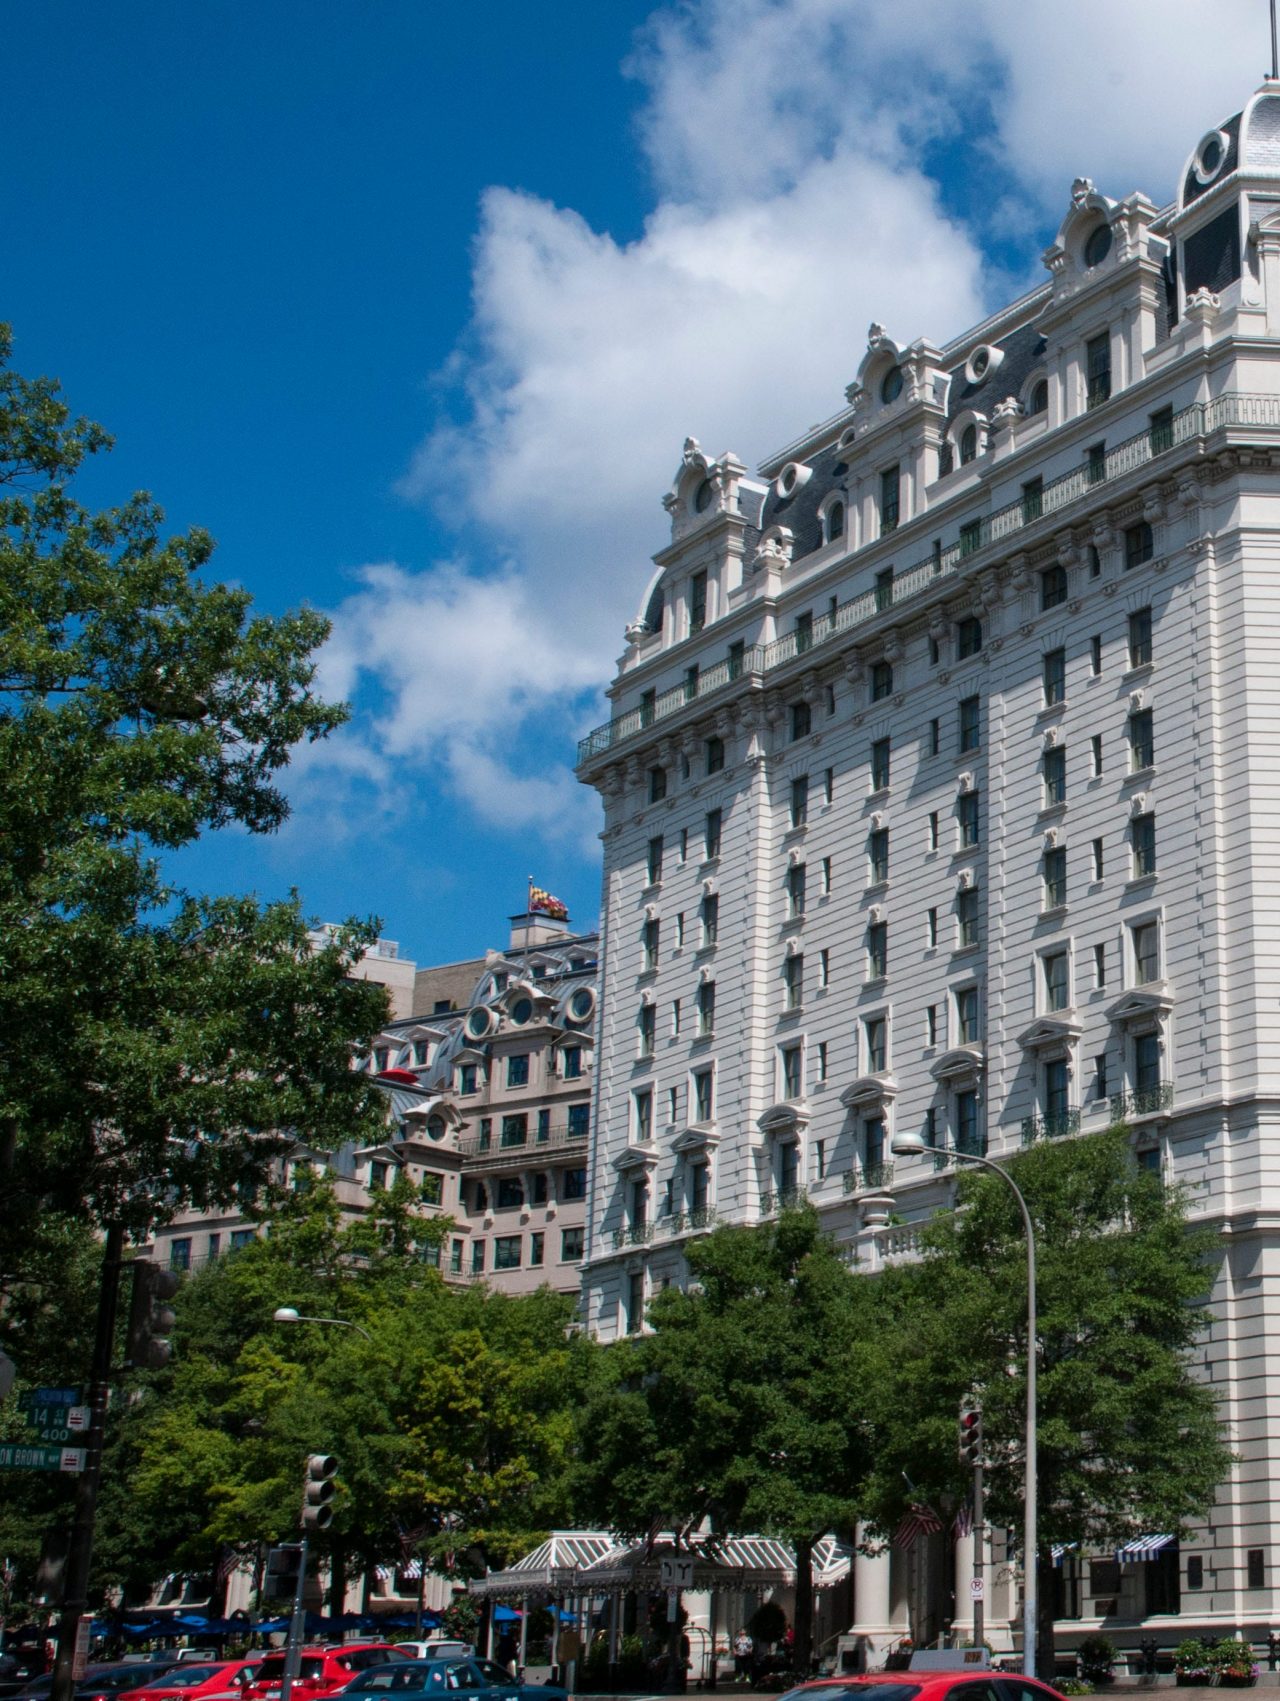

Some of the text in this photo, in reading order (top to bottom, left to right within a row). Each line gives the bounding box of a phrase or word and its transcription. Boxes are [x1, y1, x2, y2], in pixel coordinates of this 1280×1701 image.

[33, 1408, 48, 1425] 14
[41, 1429, 69, 1440] 400
[14, 1449, 46, 1466] BROWN
